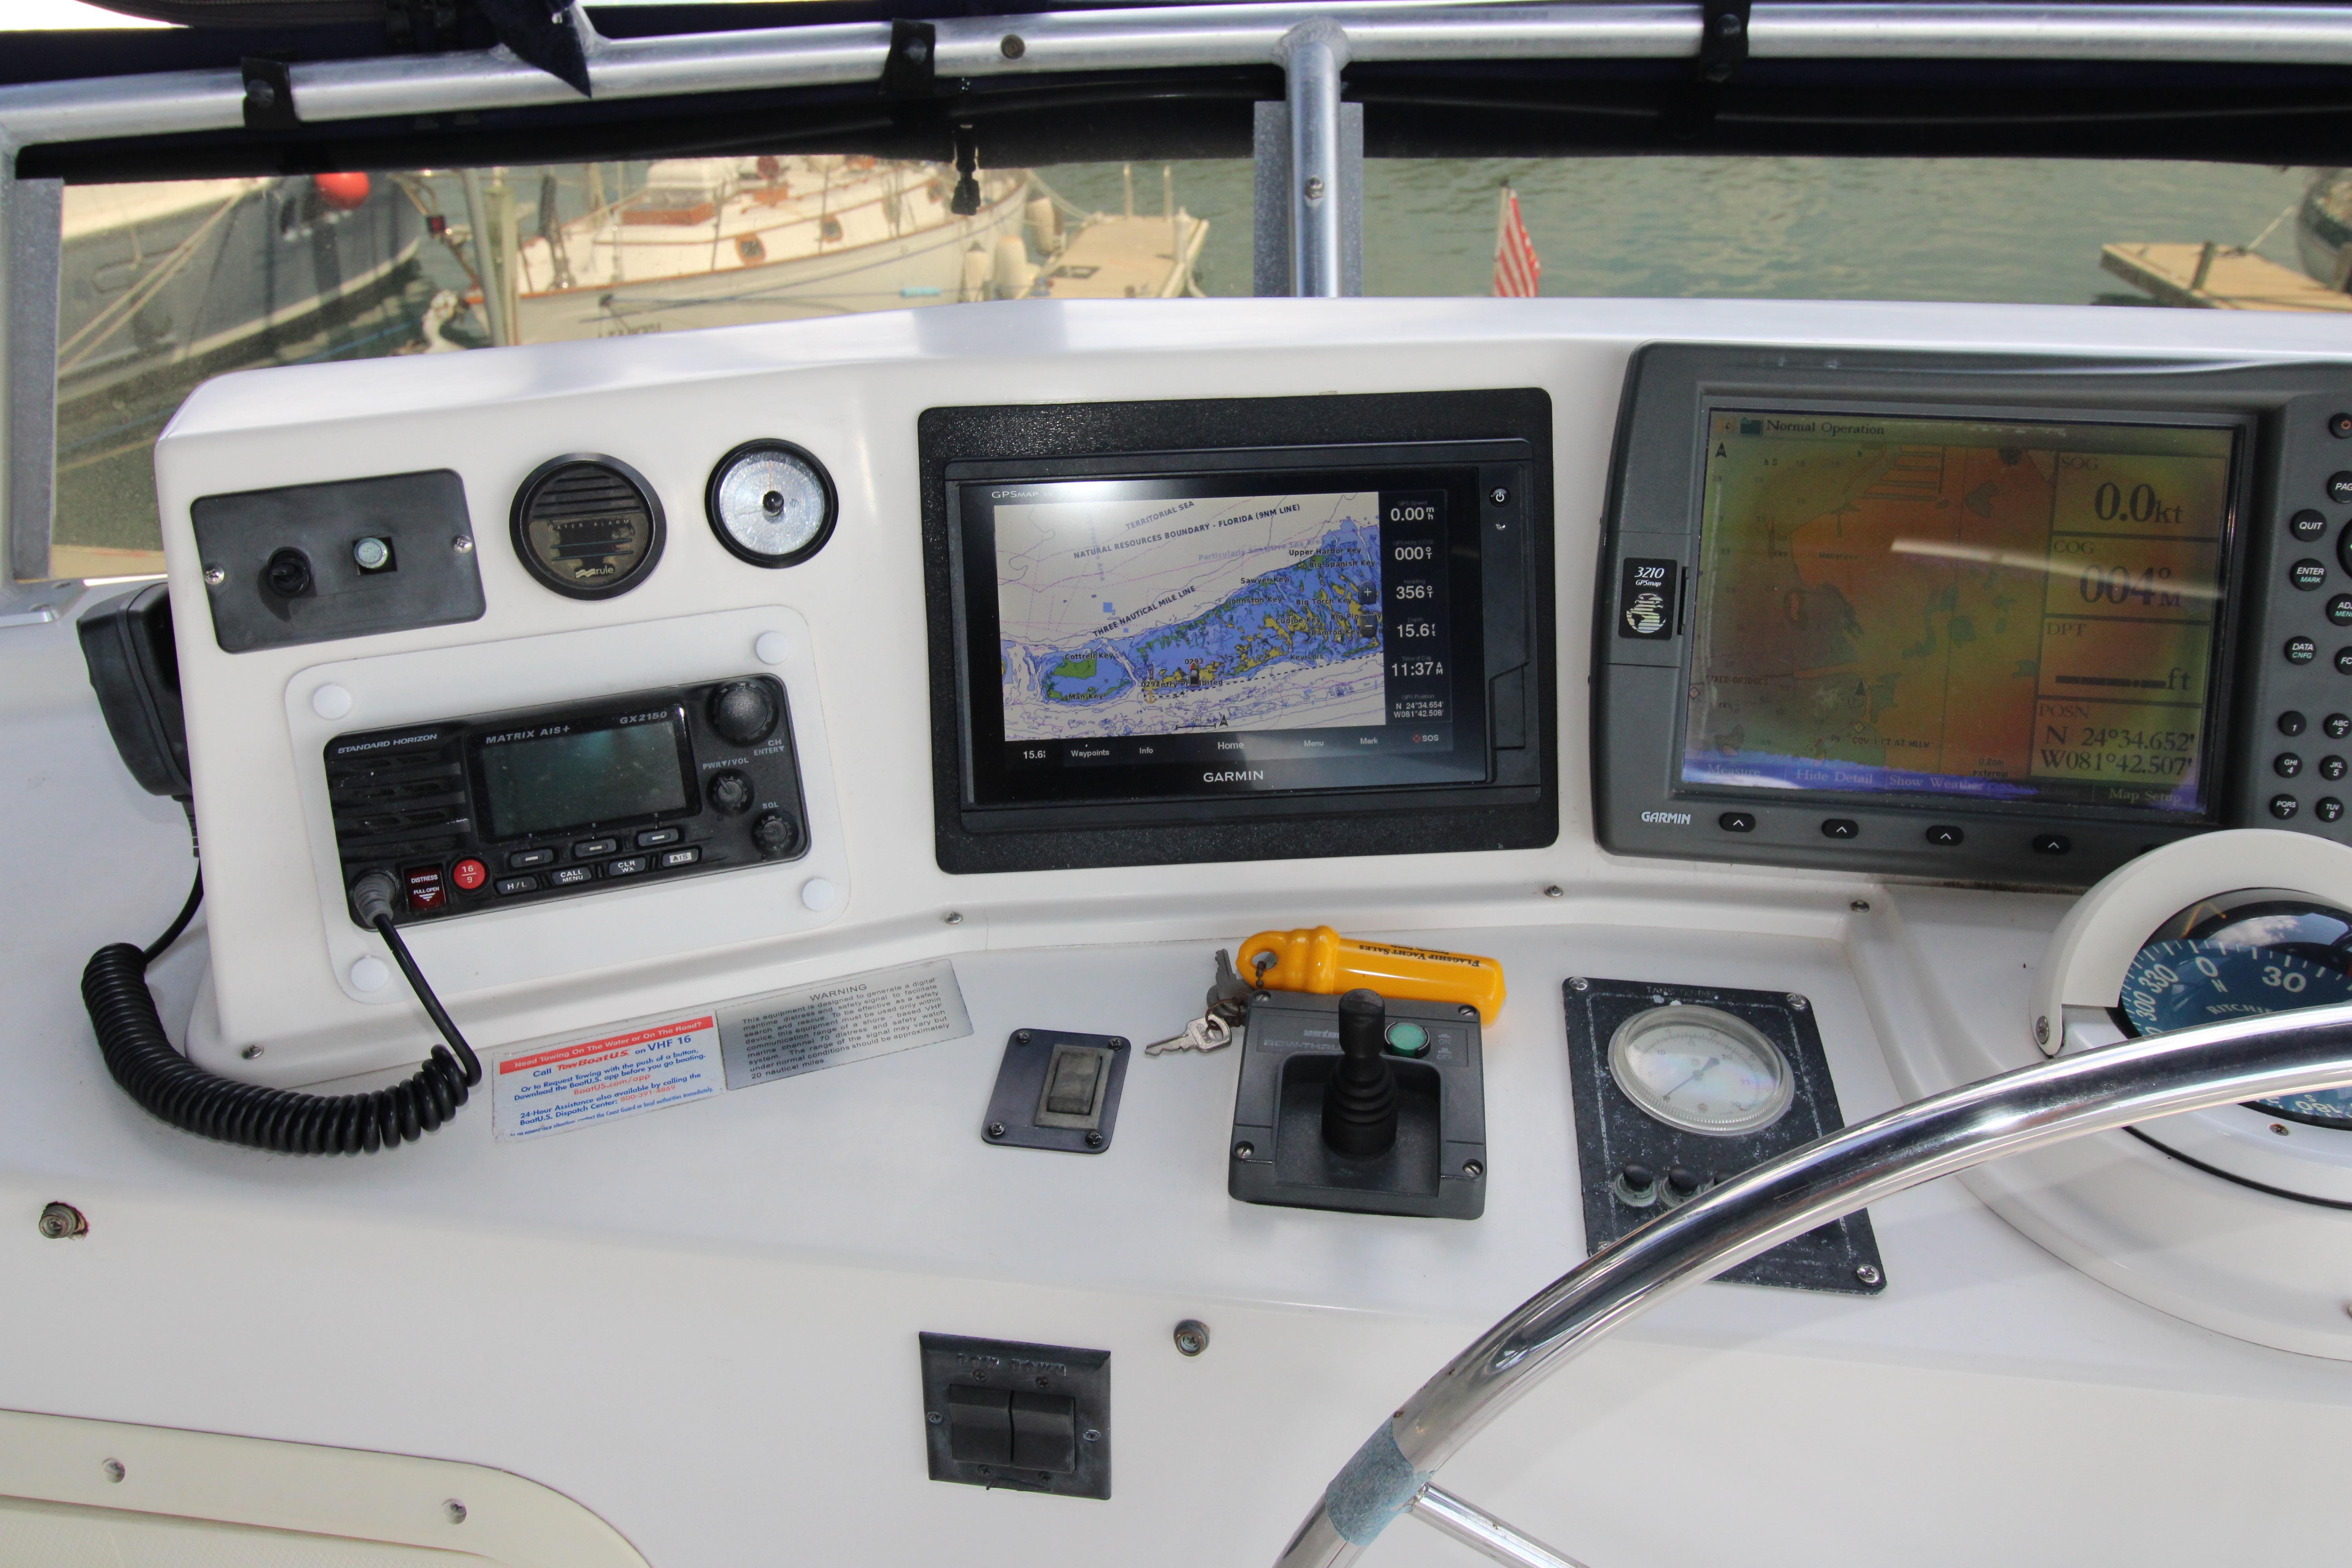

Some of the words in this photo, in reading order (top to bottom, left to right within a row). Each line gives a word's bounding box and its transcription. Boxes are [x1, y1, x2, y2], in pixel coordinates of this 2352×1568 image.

[1766, 419, 1815, 432] Normal
[1821, 422, 1884, 436] Operation
[2062, 457, 2098, 471] SOG
[1125, 506, 1178, 531] TERRITORIAL
[1178, 500, 1194, 512] SEA
[1390, 507, 1425, 521] 0.00
[1073, 544, 1112, 559] NATURAL
[1114, 534, 1162, 551] RESOURCES
[1164, 523, 1210, 539] BOUNDARY
[1218, 514, 1253, 528] FLORIDA
[1256, 509, 1277, 521] (9NM
[1279, 503, 1301, 515] LINE)
[2299, 521, 2323, 530] QUIT
[1289, 549, 1314, 557] Upper
[2054, 540, 2094, 554] COG
[595, 564, 614, 575] rule
[1634, 567, 1665, 579] 3210
[2296, 567, 2325, 575] ENTER
[1240, 577, 1271, 586] Sawyer
[1635, 579, 1662, 588] GPSmap
[1396, 585, 1425, 599] 356
[1093, 620, 1118, 637] THREE
[1119, 603, 1158, 625] NAUTICAL
[1158, 594, 1176, 607] MILE
[1175, 585, 1196, 601] LINE
[1397, 623, 1430, 638] 15.6
[2047, 622, 2086, 636] DPT
[2292, 643, 2314, 651] DATA
[1065, 652, 1096, 660] Cottrell
[1098, 652, 1114, 660] Key
[1392, 662, 1434, 677] 11:37
[620, 711, 668, 724] GX2150
[2039, 704, 2091, 719] POSN
[486, 731, 535, 744] MATRIX
[539, 725, 571, 736] AIS+
[2045, 725, 2069, 744] N
[338, 740, 390, 753] STANDARD
[393, 733, 437, 746] HORIZON
[1218, 742, 1244, 750] Home
[753, 747, 779, 756] ENTER
[1071, 749, 1110, 757] Waypoints
[1203, 770, 1264, 783] GARMIN
[1708, 763, 1761, 777] Measure
[1796, 769, 1829, 782] Hide
[1834, 771, 1873, 784] Detail
[1889, 775, 1922, 787] Show
[2109, 788, 2139, 803] Map
[2144, 790, 2181, 807] Setup
[762, 801, 779, 809] SQL
[1641, 811, 1691, 825] GARMIN
[617, 860, 636, 869] CLR
[673, 853, 688, 862] AIS
[462, 865, 474, 873] 16
[560, 868, 583, 878] CALL
[411, 874, 438, 884] DISTRESS
[562, 875, 584, 883] MENU
[2195, 956, 2219, 977] 0
[2138, 963, 2179, 994] 330
[2261, 965, 2307, 993] 30
[809, 984, 867, 1001] WARNING
[2210, 979, 2228, 993] N
[762, 1006, 806, 1020] equipment
[817, 995, 853, 1007] designed
[866, 985, 902, 998] generate
[912, 977, 935, 987] digital
[2132, 991, 2156, 1022] 300
[514, 1057, 537, 1068] Need
[539, 1051, 570, 1062] Towing
[604, 1038, 629, 1047] Water
[675, 1021, 702, 1032] Road?
[532, 1067, 552, 1077] Call
[647, 1038, 673, 1051] VHF
[677, 1034, 691, 1044] 16
[543, 1076, 573, 1087] Request
[574, 1071, 601, 1080] Towing
[603, 1065, 620, 1074] with
[621, 1063, 634, 1072] the
[635, 1057, 653, 1068] push
[672, 1049, 699, 1060] button,
[573, 1074, 650, 1095] BoatUS.com/app
[555, 1105, 588, 1118] Dispatch
[590, 1100, 617, 1109] Center:
[620, 1084, 675, 1102] 800-391-4869
